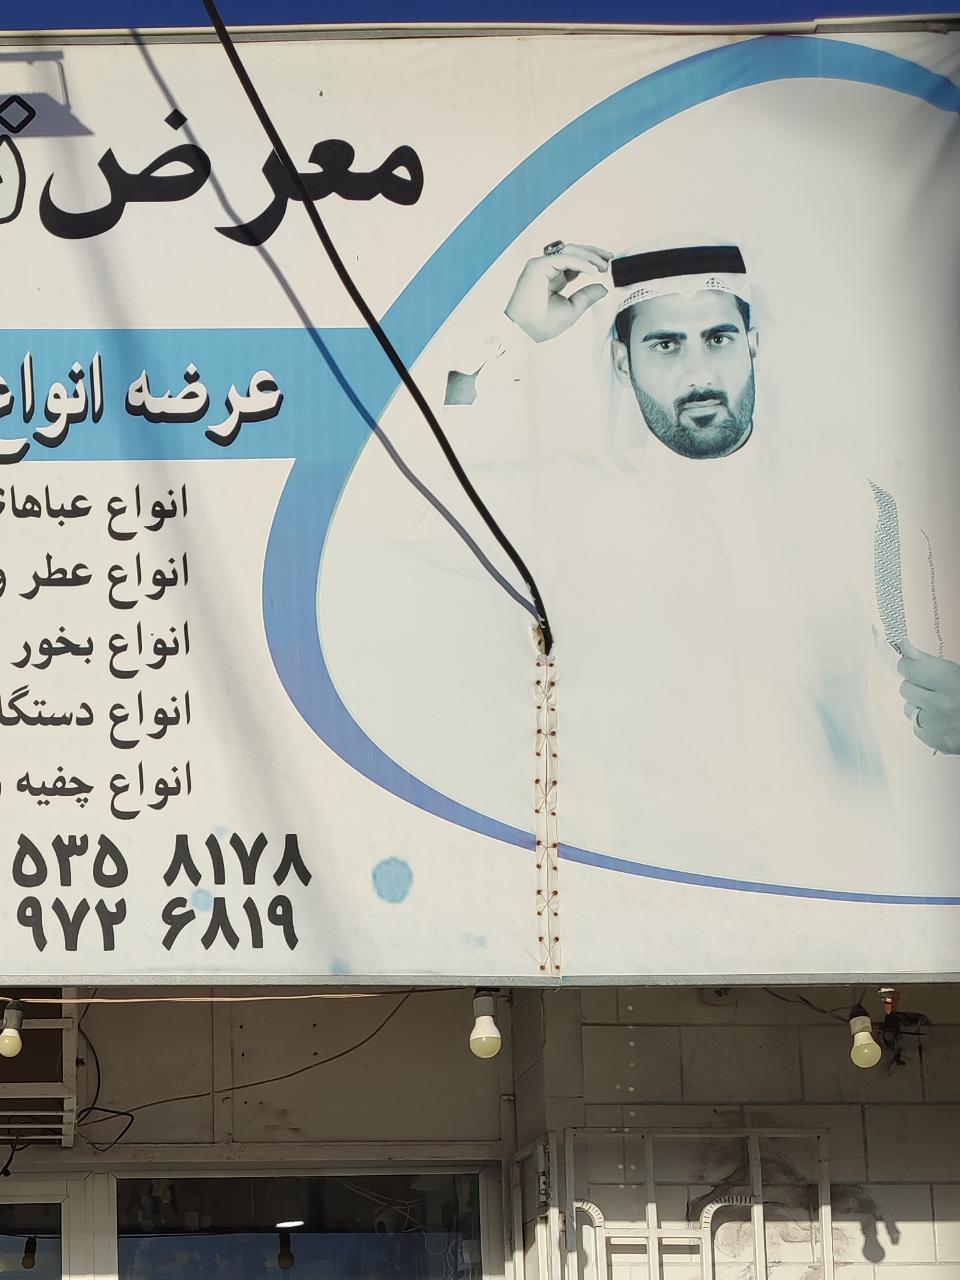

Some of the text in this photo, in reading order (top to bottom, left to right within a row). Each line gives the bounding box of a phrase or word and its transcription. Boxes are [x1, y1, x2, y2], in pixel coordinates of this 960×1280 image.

[40, 109, 425, 247] معرض
[124, 362, 285, 447] عرضه
[107, 483, 188, 541] انواع
[19, 553, 92, 600] عطر
[107, 552, 189, 609] انواع
[11, 625, 93, 670] بخور
[108, 621, 190, 679] انواع
[109, 691, 191, 749] انواع
[16, 766, 94, 808] چفیه
[110, 760, 192, 820] انواع
[12, 833, 129, 888] ۵۳۵
[163, 833, 313, 887] ۸۱۷۸
[16, 896, 127, 952] ۹۷۲
[161, 894, 299, 951] ۶۸۱۹
